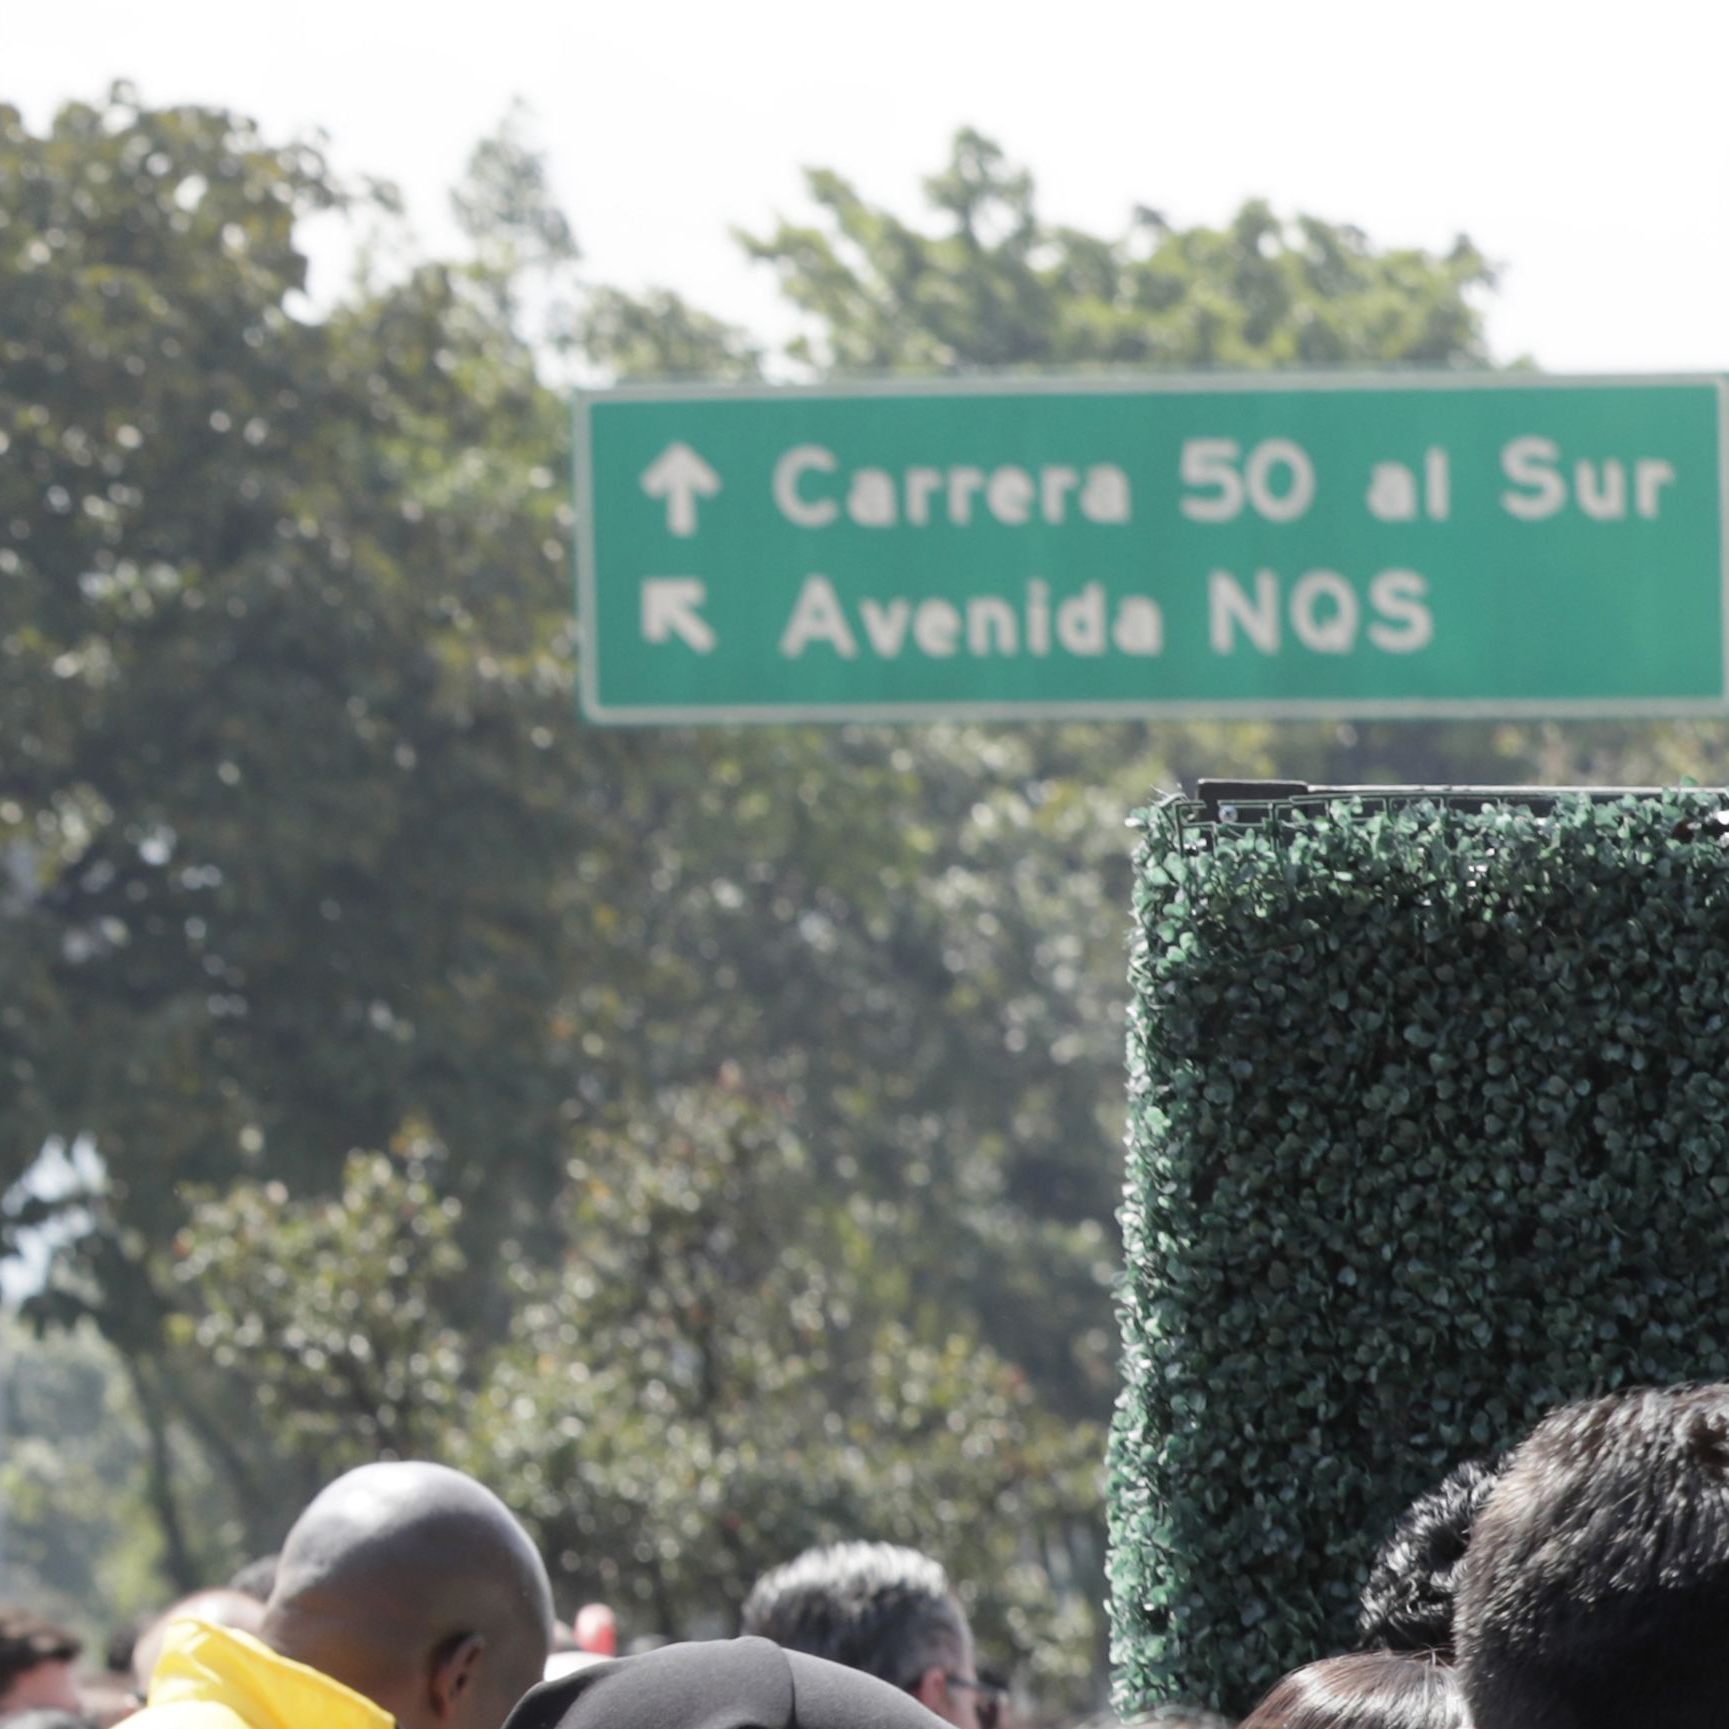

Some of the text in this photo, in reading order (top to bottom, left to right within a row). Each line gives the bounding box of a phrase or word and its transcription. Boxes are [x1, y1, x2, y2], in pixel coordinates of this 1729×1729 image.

[772, 435, 1676, 528] Carrera 50 al Sur
[780, 568, 1435, 657] Avenida NQS
